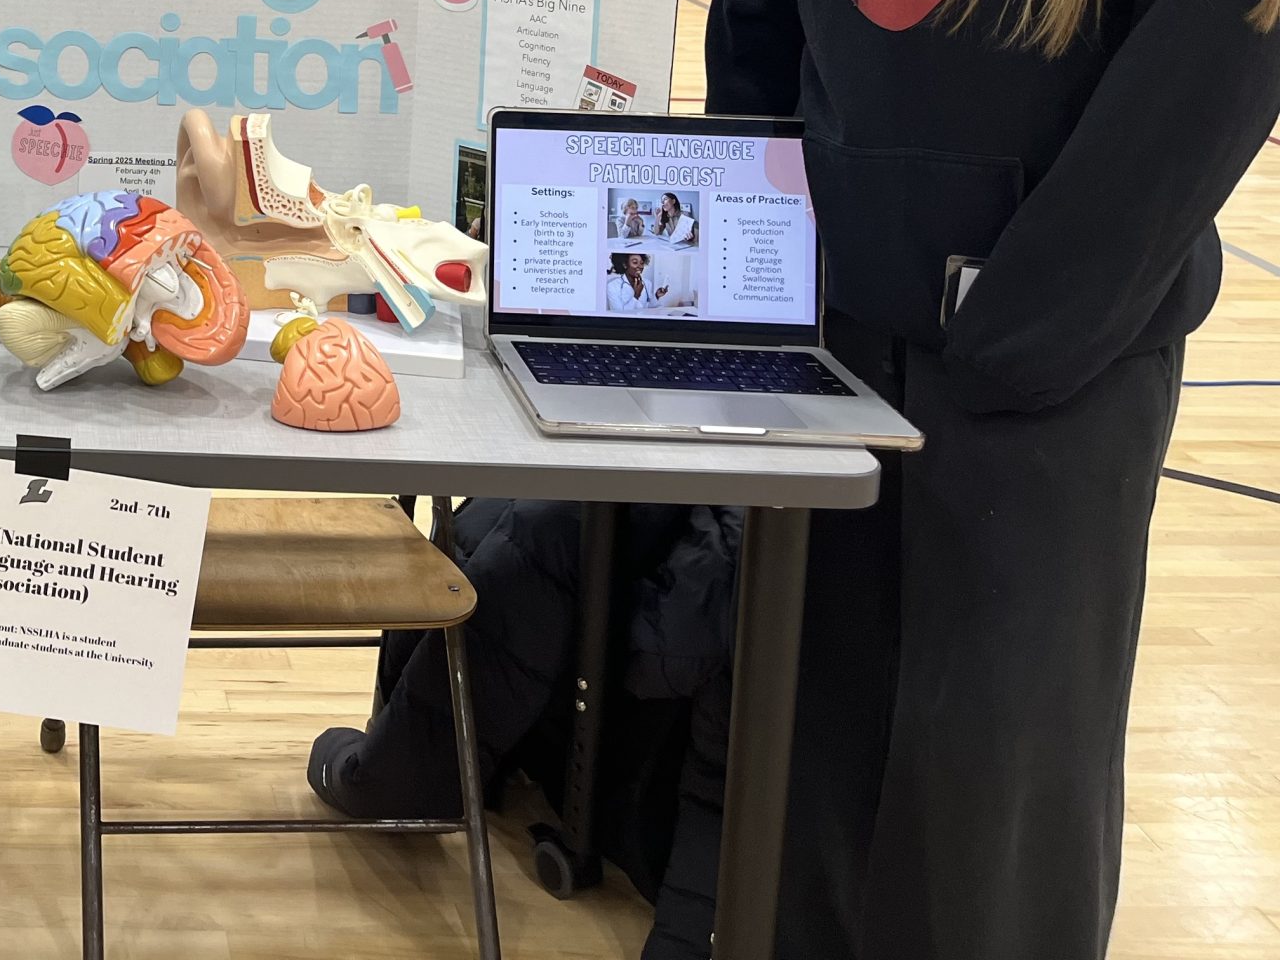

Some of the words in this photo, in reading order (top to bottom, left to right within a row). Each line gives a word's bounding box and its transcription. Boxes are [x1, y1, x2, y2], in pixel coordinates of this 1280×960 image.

[529, 14, 547, 24] AAC
[516, 26, 559, 39] Articulation
[518, 39, 555, 52] Cognition
[521, 53, 551, 67] Fluency
[520, 66, 550, 81] Hearing
[595, 71, 624, 90] TODAY
[516, 79, 553, 94] Language
[520, 93, 548, 108] Speech
[18, 137, 85, 162] SPEECHIE
[565, 135, 645, 157] SPEECH
[651, 137, 754, 160] LANGAUGE
[87, 156, 114, 165] Spring
[115, 156, 134, 164] 2025
[135, 157, 166, 165] Meeting
[115, 167, 147, 176] February
[588, 162, 725, 187] PATHOLOGIST
[531, 187, 574, 198] Settings:
[715, 194, 743, 203] Areas
[745, 194, 756, 203] of
[758, 195, 801, 205] Practice:
[539, 210, 568, 218] Schools
[520, 218, 539, 229] Early
[541, 220, 587, 230] Intervention
[737, 217, 765, 227] Speech
[766, 218, 791, 227] Sound
[533, 229, 555, 237] (birth
[566, 230, 574, 238] 3)
[742, 226, 784, 236] production
[533, 238, 573, 247] healthcare
[753, 237, 774, 245] Voice
[538, 249, 568, 257] settings
[749, 246, 779, 256] Fluency
[524, 257, 551, 265] private
[552, 256, 582, 266] practice
[745, 255, 782, 265] Language
[523, 267, 566, 275] univeristies
[745, 264, 782, 274] Cognition
[742, 273, 784, 285] Swallowing
[530, 285, 575, 294] telepractice
[742, 283, 784, 292] Alternative
[732, 292, 793, 302] Communication
[109, 498, 143, 513] 2nd-
[147, 504, 170, 518] 7th
[87, 541, 163, 567] Student
[57, 563, 95, 579] and
[99, 566, 179, 596] Hearing
[20, 626, 60, 640] NSSLHA
[62, 631, 70, 640] is
[80, 636, 116, 648] student
